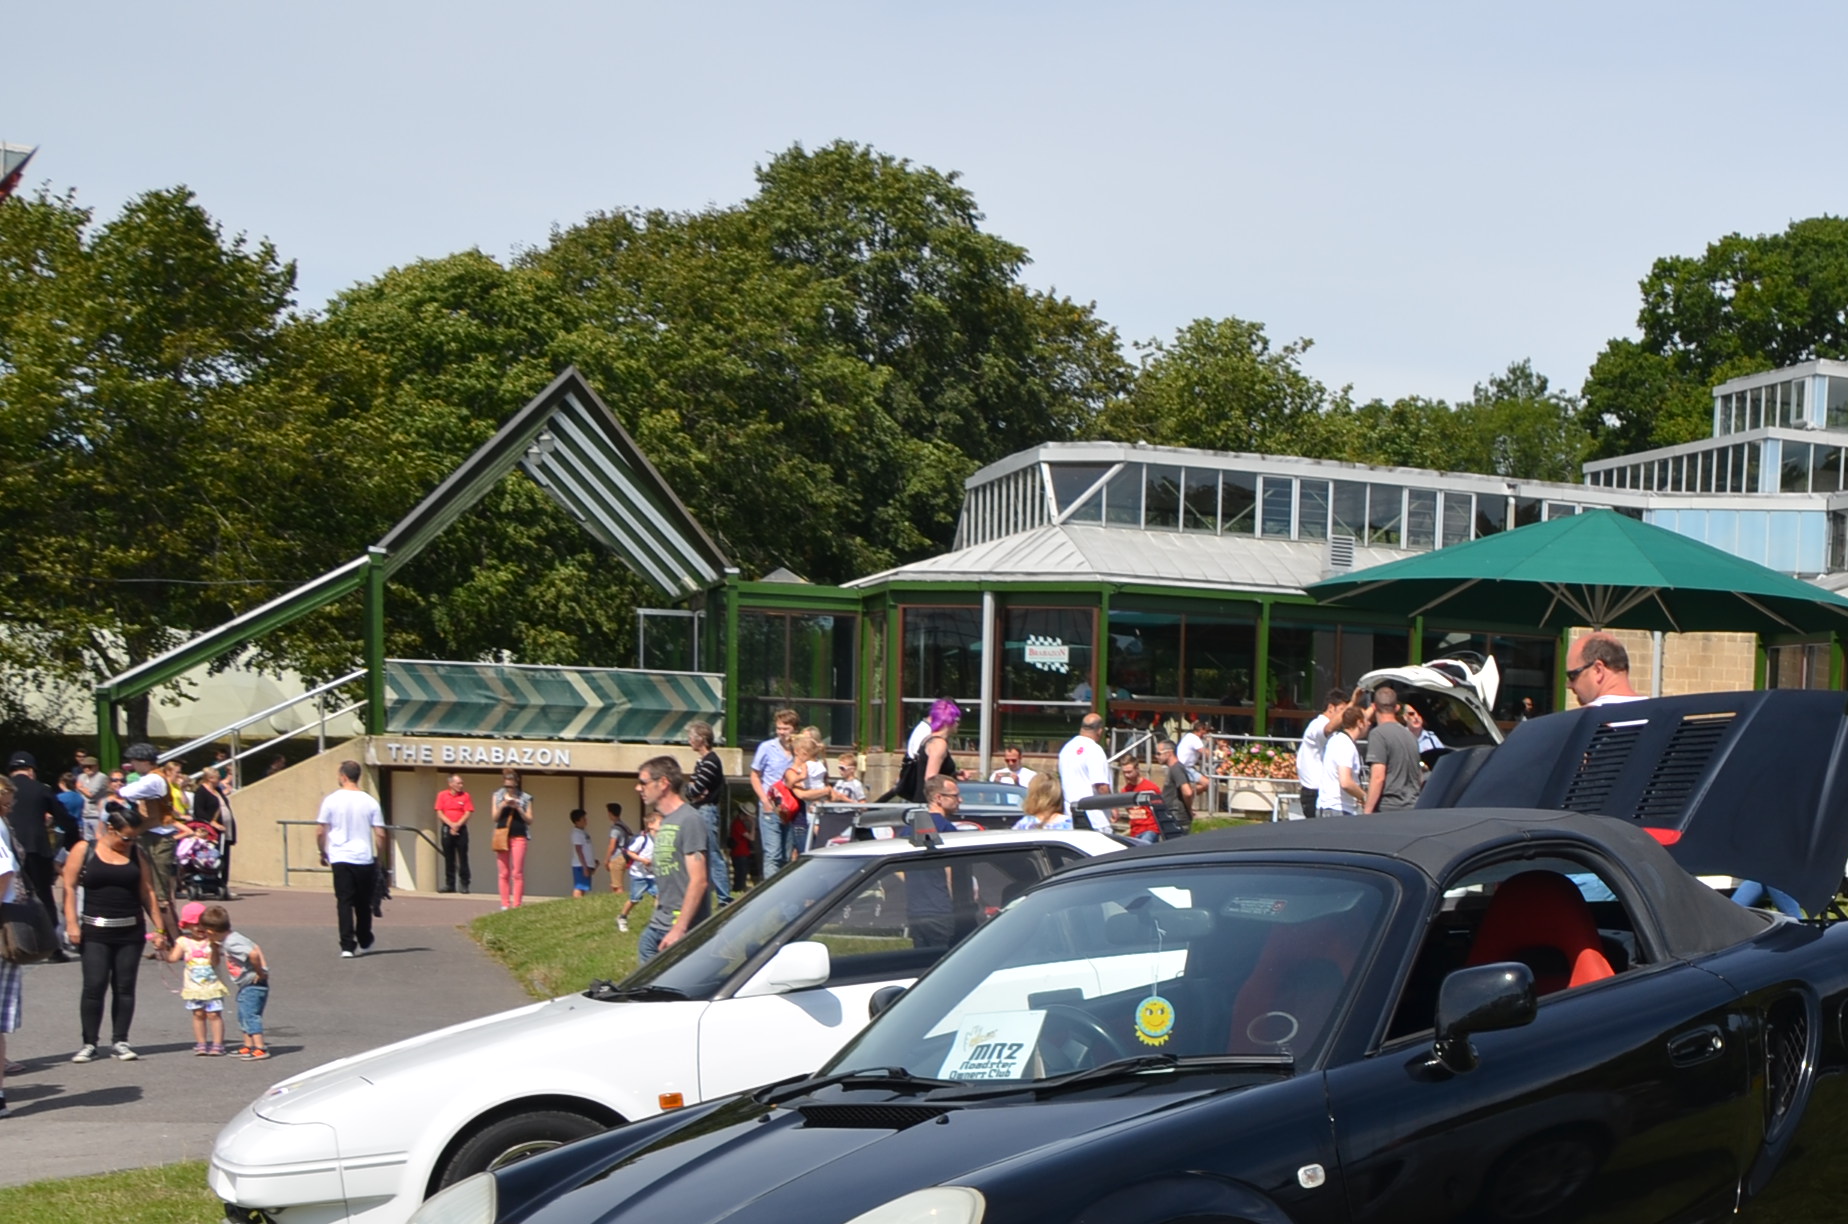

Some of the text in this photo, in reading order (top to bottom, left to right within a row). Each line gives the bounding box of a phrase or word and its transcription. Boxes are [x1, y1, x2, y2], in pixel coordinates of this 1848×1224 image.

[387, 743, 571, 766] THE BRABAZON
[969, 1043, 1024, 1060] MR2
[960, 1060, 1017, 1070] Roadster
[988, 1069, 1011, 1077] Club
